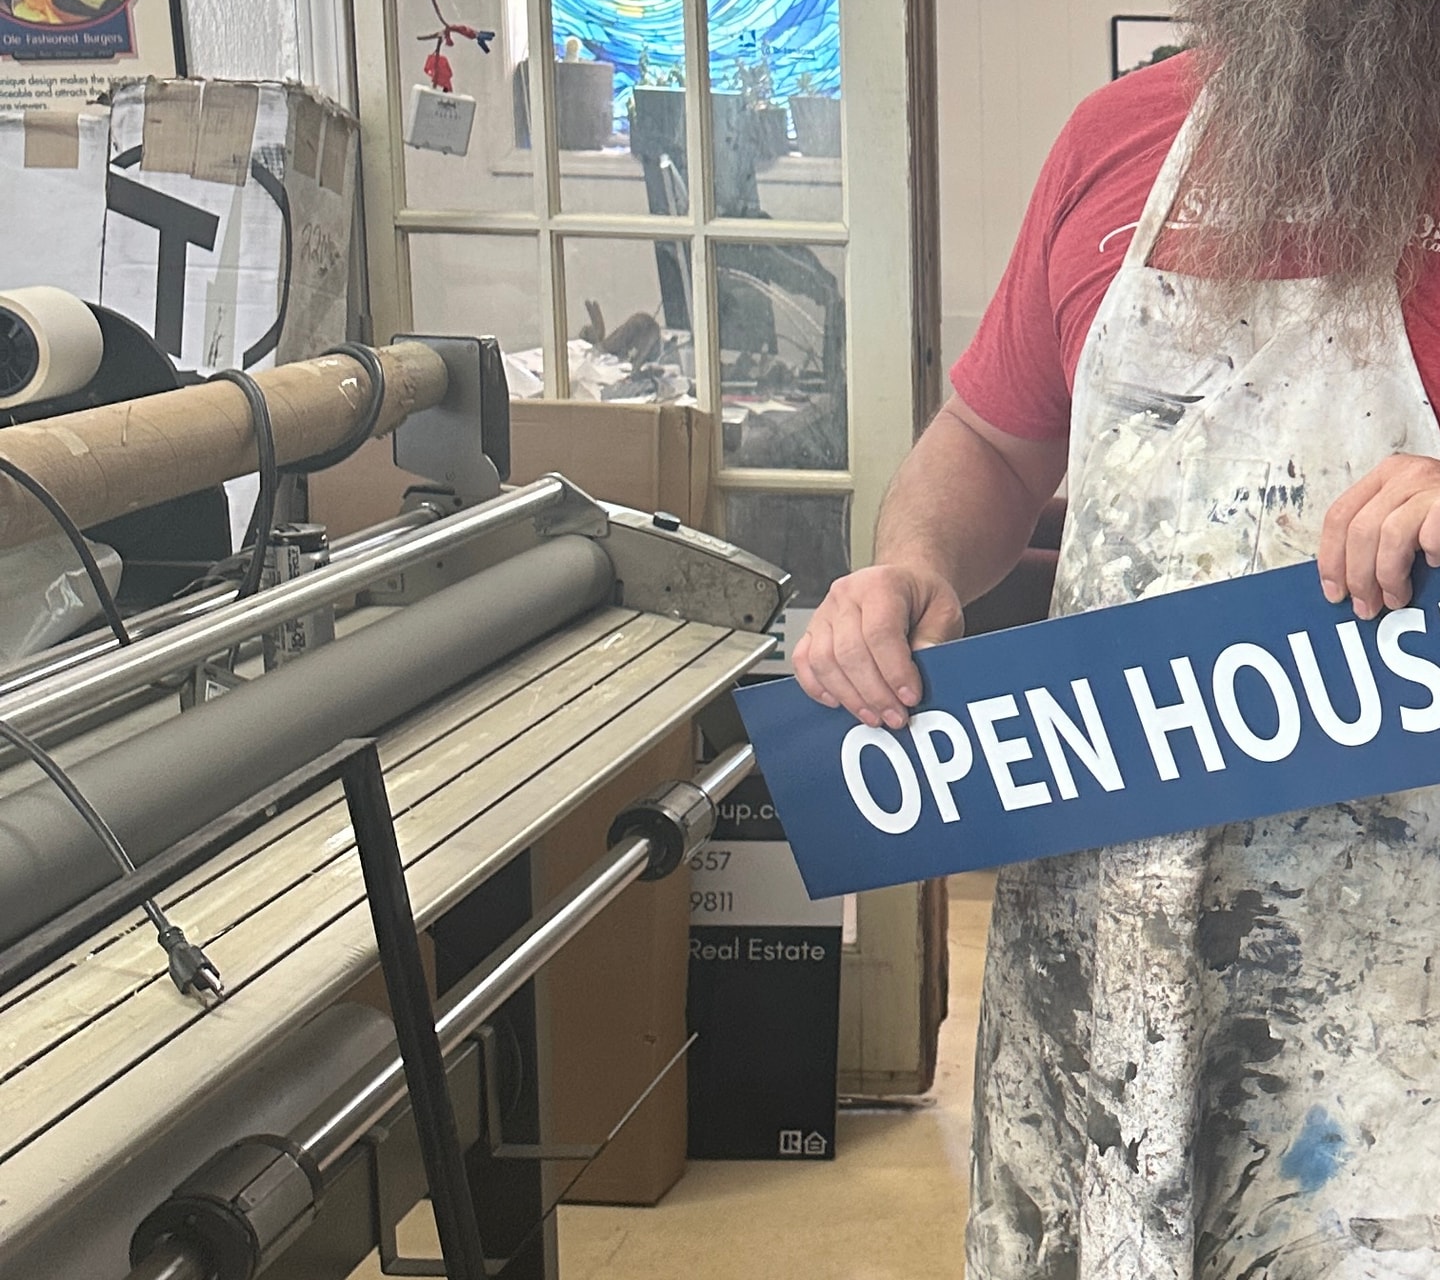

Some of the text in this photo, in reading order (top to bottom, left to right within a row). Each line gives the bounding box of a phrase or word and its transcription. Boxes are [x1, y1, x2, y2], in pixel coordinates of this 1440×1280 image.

[840, 677, 1125, 836] OPEN
[688, 936, 826, 962] Real Estate
